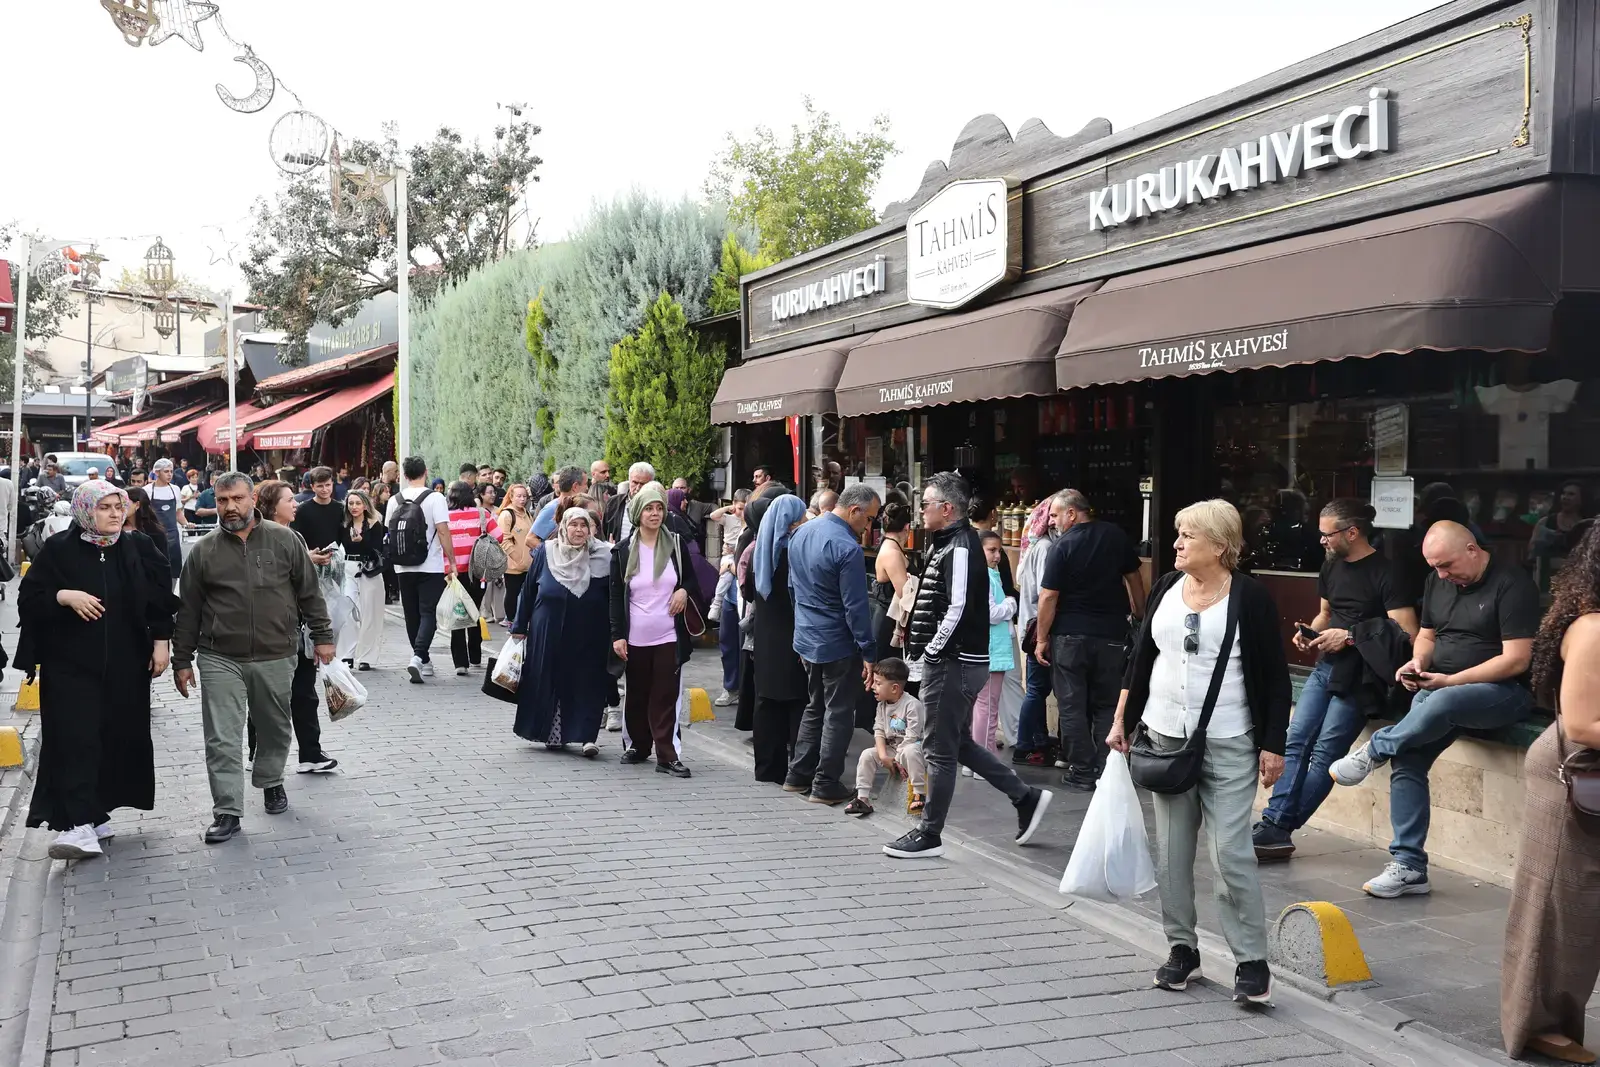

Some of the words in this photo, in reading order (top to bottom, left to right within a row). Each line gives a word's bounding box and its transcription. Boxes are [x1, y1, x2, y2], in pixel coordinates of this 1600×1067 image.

[1089, 87, 1390, 231] KURUKAHVECİ
[914, 193, 998, 257] TAHMİS
[937, 248, 972, 276] KAHVESİ
[771, 253, 889, 322] KURUKAHVECİ
[1138, 340, 1206, 368] TAHMİS
[1210, 329, 1289, 360] KAHVESİ
[736, 400, 759, 414] TAHMİS
[758, 397, 783, 411] KAHVESİ
[879, 383, 914, 403] TAHMİS
[915, 377, 954, 398] KAHVESİ
